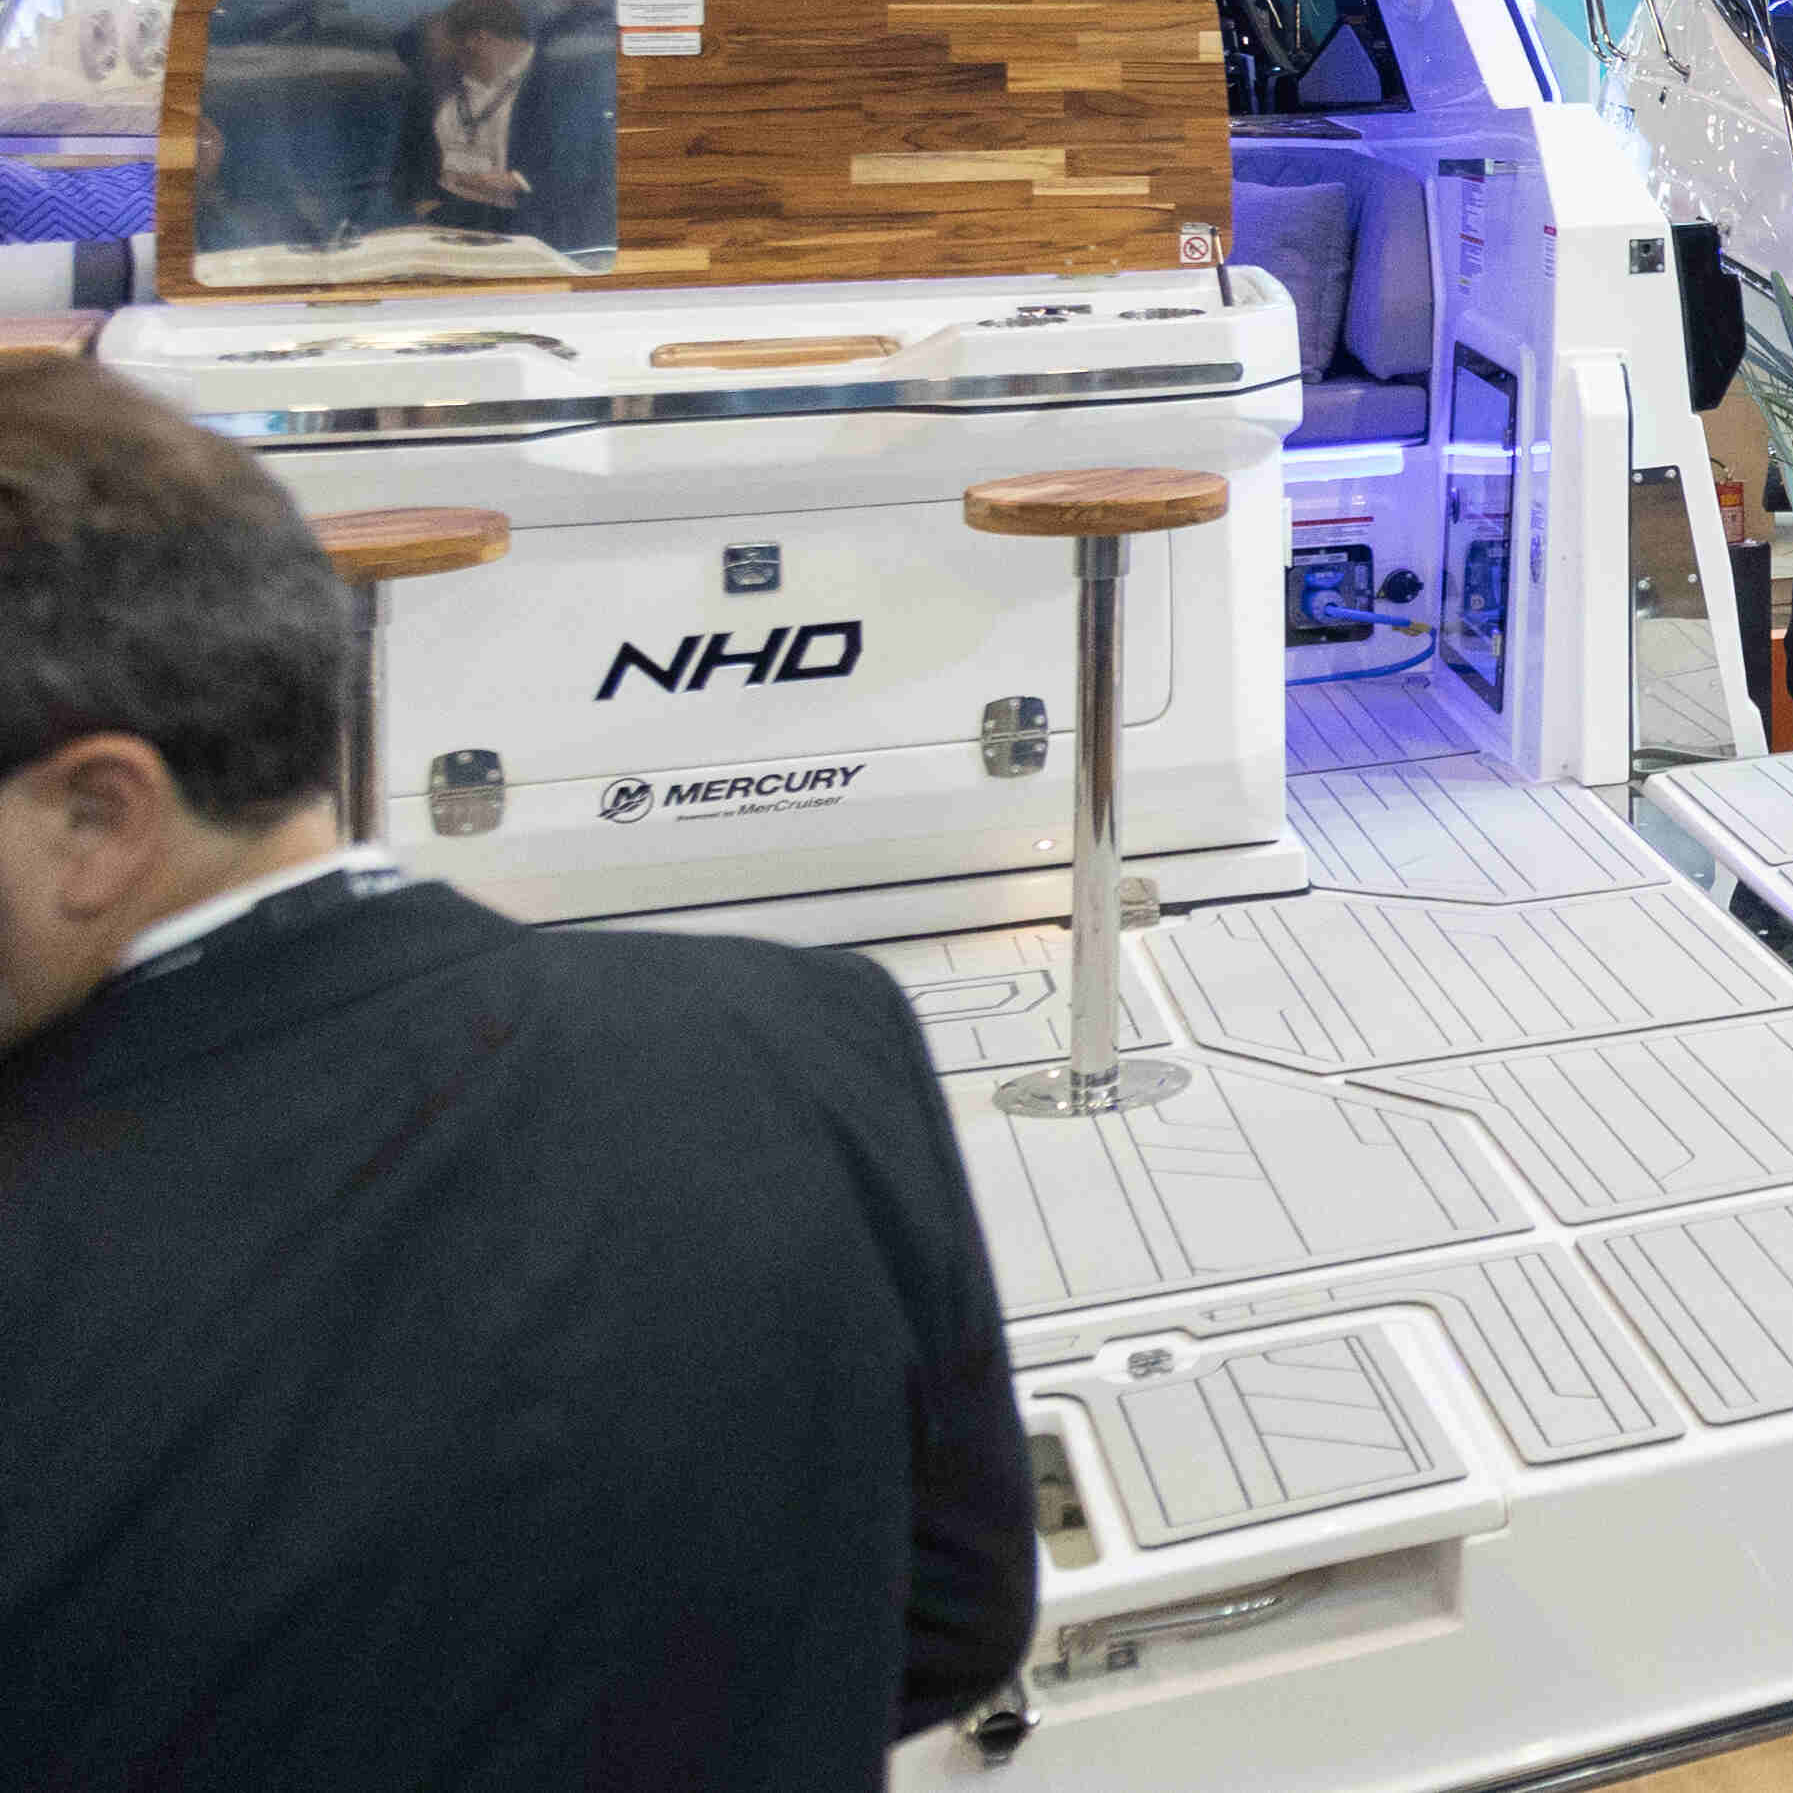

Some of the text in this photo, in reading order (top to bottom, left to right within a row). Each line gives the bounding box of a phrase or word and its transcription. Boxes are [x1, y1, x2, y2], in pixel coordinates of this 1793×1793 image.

[592, 619, 862, 702] NHD
[662, 763, 867, 808] MERCURY
[736, 794, 844, 818] MerCruiser
